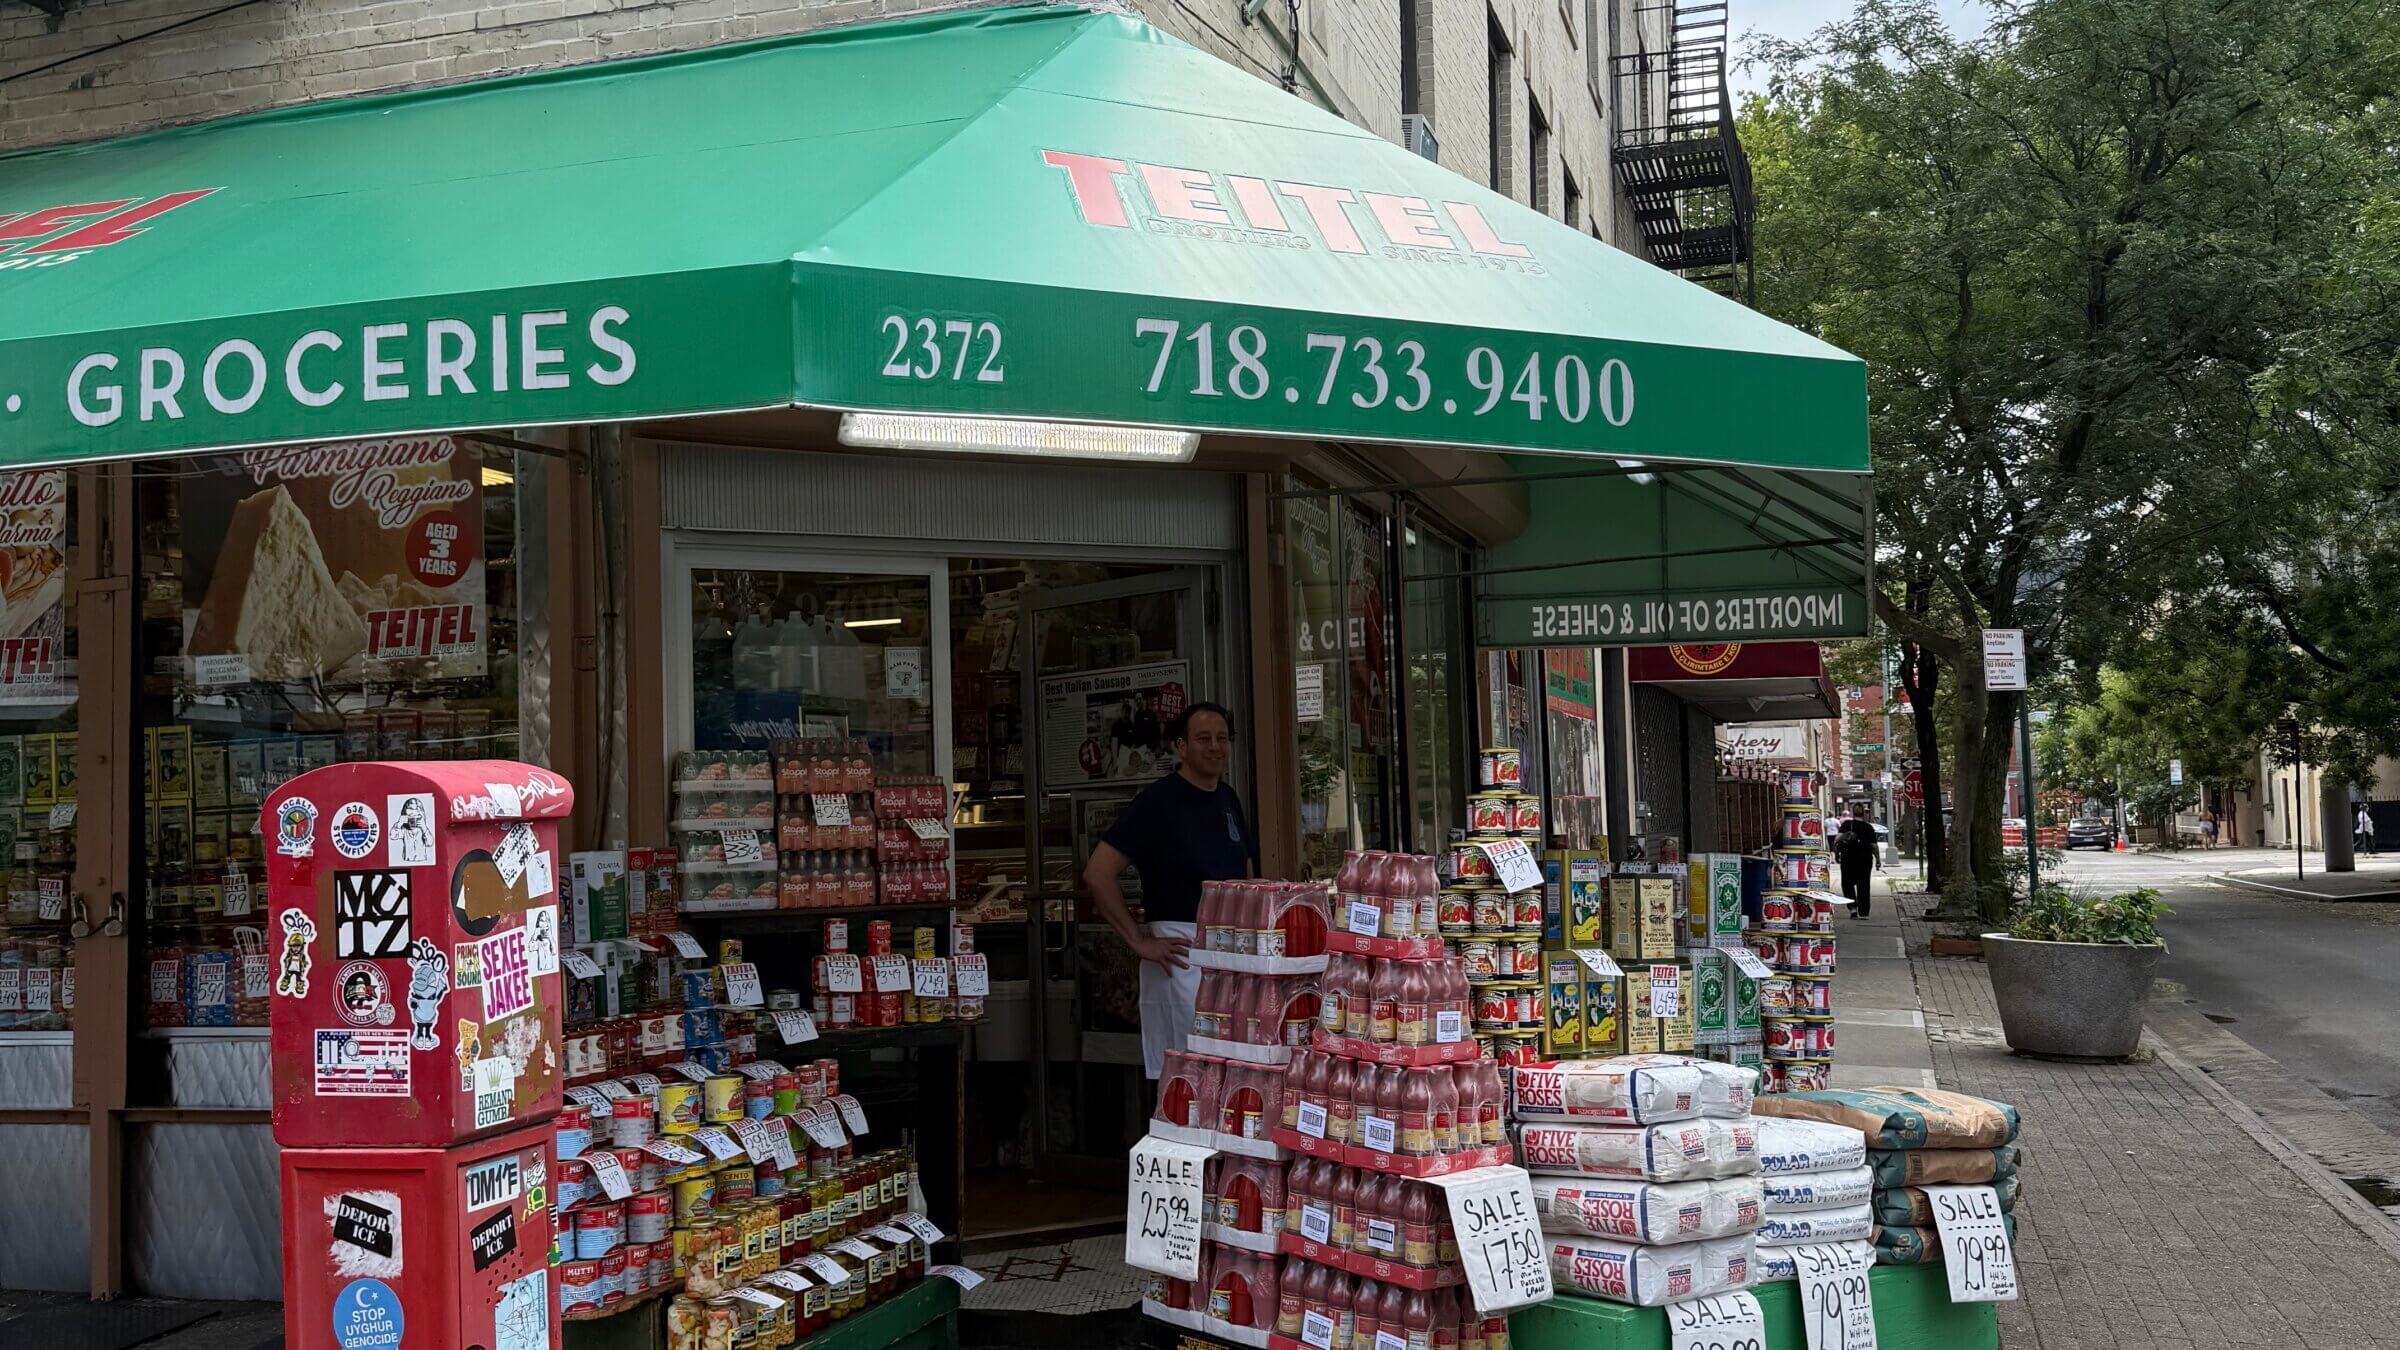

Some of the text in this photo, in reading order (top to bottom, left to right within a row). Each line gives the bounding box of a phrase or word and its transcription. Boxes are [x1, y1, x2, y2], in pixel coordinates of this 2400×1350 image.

[1042, 149, 1533, 258] TEITEL
[1147, 217, 1312, 250] BROTHERS
[1383, 246, 1466, 266] SINCE
[881, 314, 1004, 383] 2372
[67, 306, 637, 427] GROCERIES
[1135, 317, 1635, 427] 718.733.9400
[243, 434, 456, 509] Parmigiano
[363, 473, 473, 529] Reggiano
[425, 522, 458, 540] AGED
[429, 539, 450, 558] 3
[419, 557, 457, 576] YEARS
[366, 604, 477, 660] TEITEL
[0, 637, 53, 684] TEL
[1045, 676, 1131, 696] Best Italian Sausage
[1162, 693, 1181, 706] BEST
[1730, 733, 1782, 753] kery
[1906, 780, 1923, 793] ST
[279, 798, 308, 815] LOCAL
[346, 805, 364, 814] 638
[280, 834, 314, 848] NEW YORK
[333, 823, 378, 856] STEAMFITTERS
[456, 944, 479, 959] PRINC
[481, 931, 529, 981] SEXEE
[1652, 966, 1677, 979] TEITEL
[487, 968, 531, 1019] JAKEE
[1529, 1072, 1565, 1089] FIVE
[1517, 1089, 1565, 1107] ROSES
[478, 1106, 508, 1126] GUMB
[1540, 1130, 1577, 1147] FIVE
[1136, 1152, 1193, 1179] SALE
[1526, 1147, 1577, 1165] ROSES
[1760, 1154, 1810, 1173] POLAR
[723, 1172, 749, 1180] CENTO
[1141, 1190, 1190, 1238] 25.99
[1463, 1190, 1526, 1232] SALE
[1583, 1199, 1635, 1217] ROSES
[1940, 1192, 1997, 1222] SALE
[471, 1213, 514, 1251] DEPORT
[1586, 1217, 1622, 1234] FIVE
[352, 1226, 377, 1245] ICE
[486, 1240, 504, 1259] ICE
[1796, 1241, 1862, 1273] SALE
[1482, 1228, 1540, 1293] 17.50
[1574, 1257, 1626, 1279] ROSES
[1957, 1234, 2006, 1291] 29.99
[567, 1265, 595, 1277] MUTTI
[1578, 1278, 1615, 1296] FIVE
[352, 1307, 386, 1323] STOP
[1674, 1294, 1755, 1327] SALE
[345, 1321, 394, 1336] UYGHUR
[344, 1334, 399, 1350] GENOCIDE
